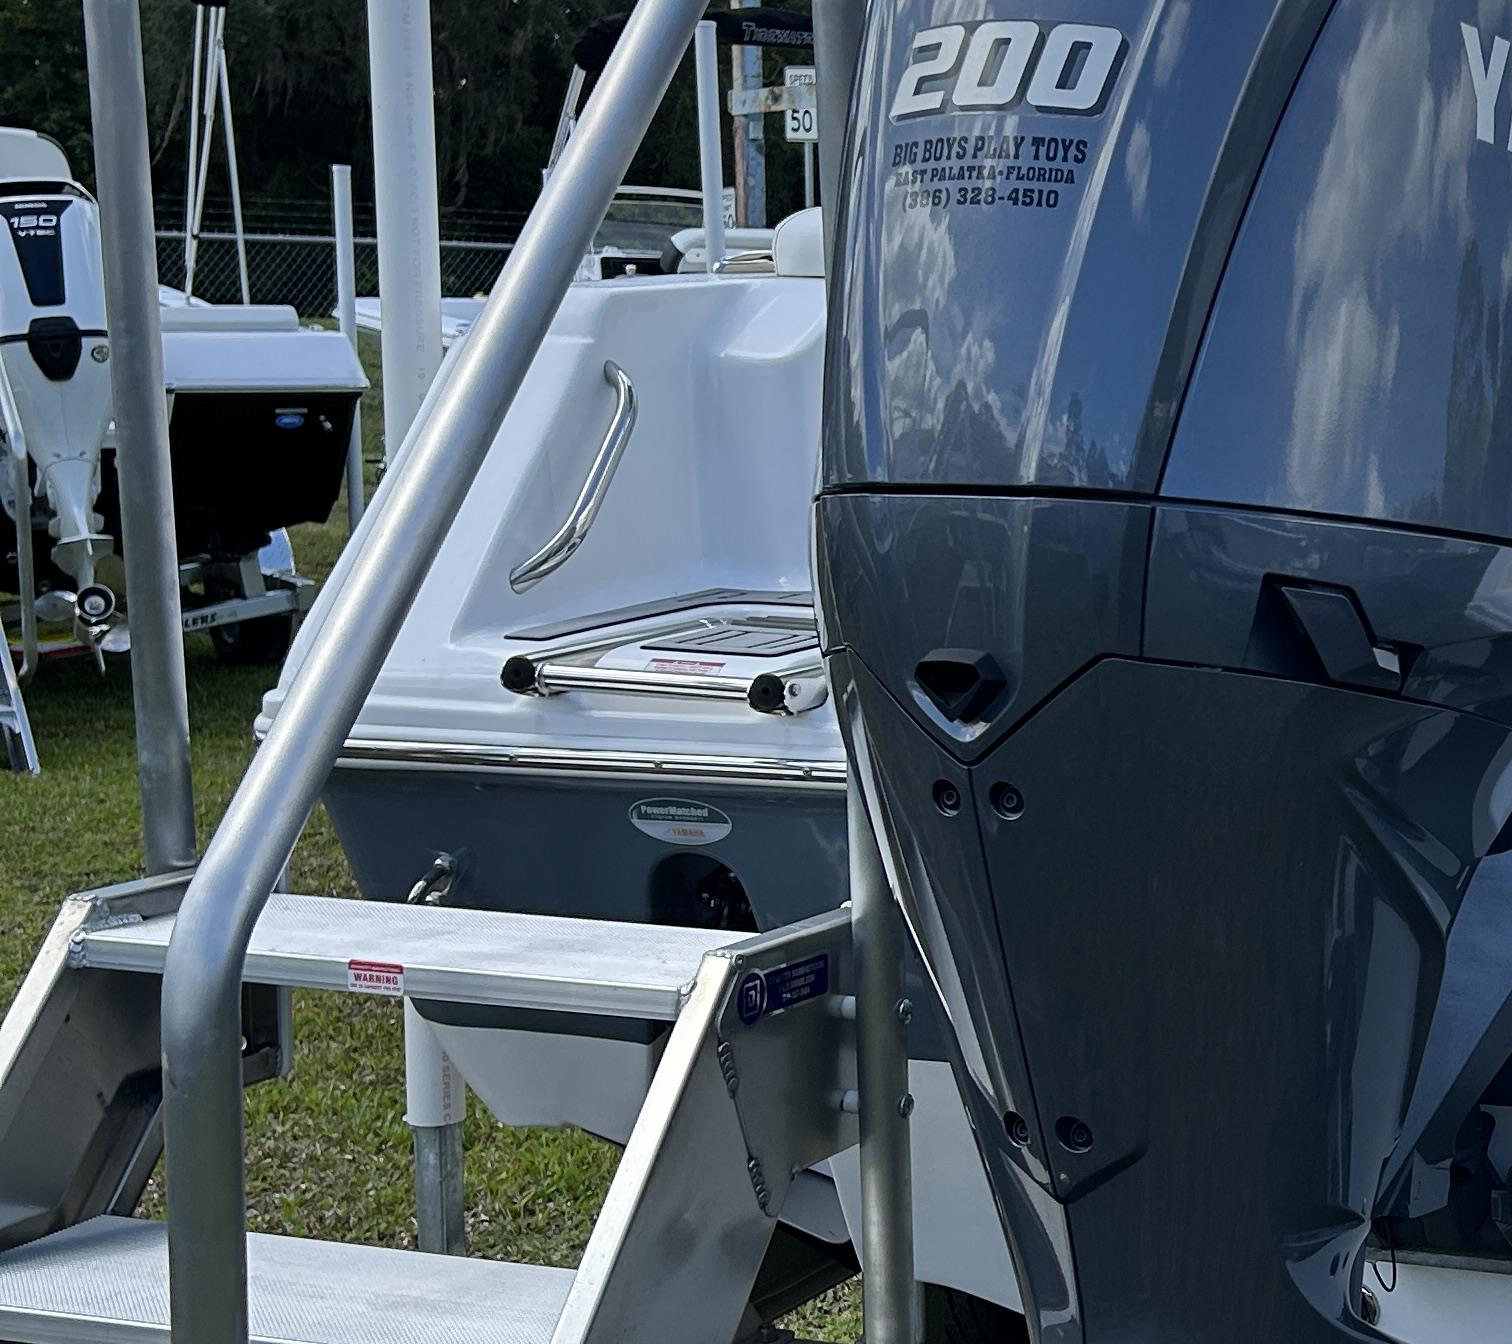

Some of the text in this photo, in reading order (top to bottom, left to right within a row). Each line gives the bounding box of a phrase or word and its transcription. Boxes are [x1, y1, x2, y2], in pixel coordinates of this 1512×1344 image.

[889, 20, 1130, 118] 200
[791, 109, 813, 133] 50
[892, 135, 1088, 167] BIG BOYS PLAY TOYS
[895, 169, 927, 188] EAST
[956, 187, 1060, 209] 328-4510
[353, 972, 399, 986] WARNING
[442, 1064, 451, 1110] SERIES
